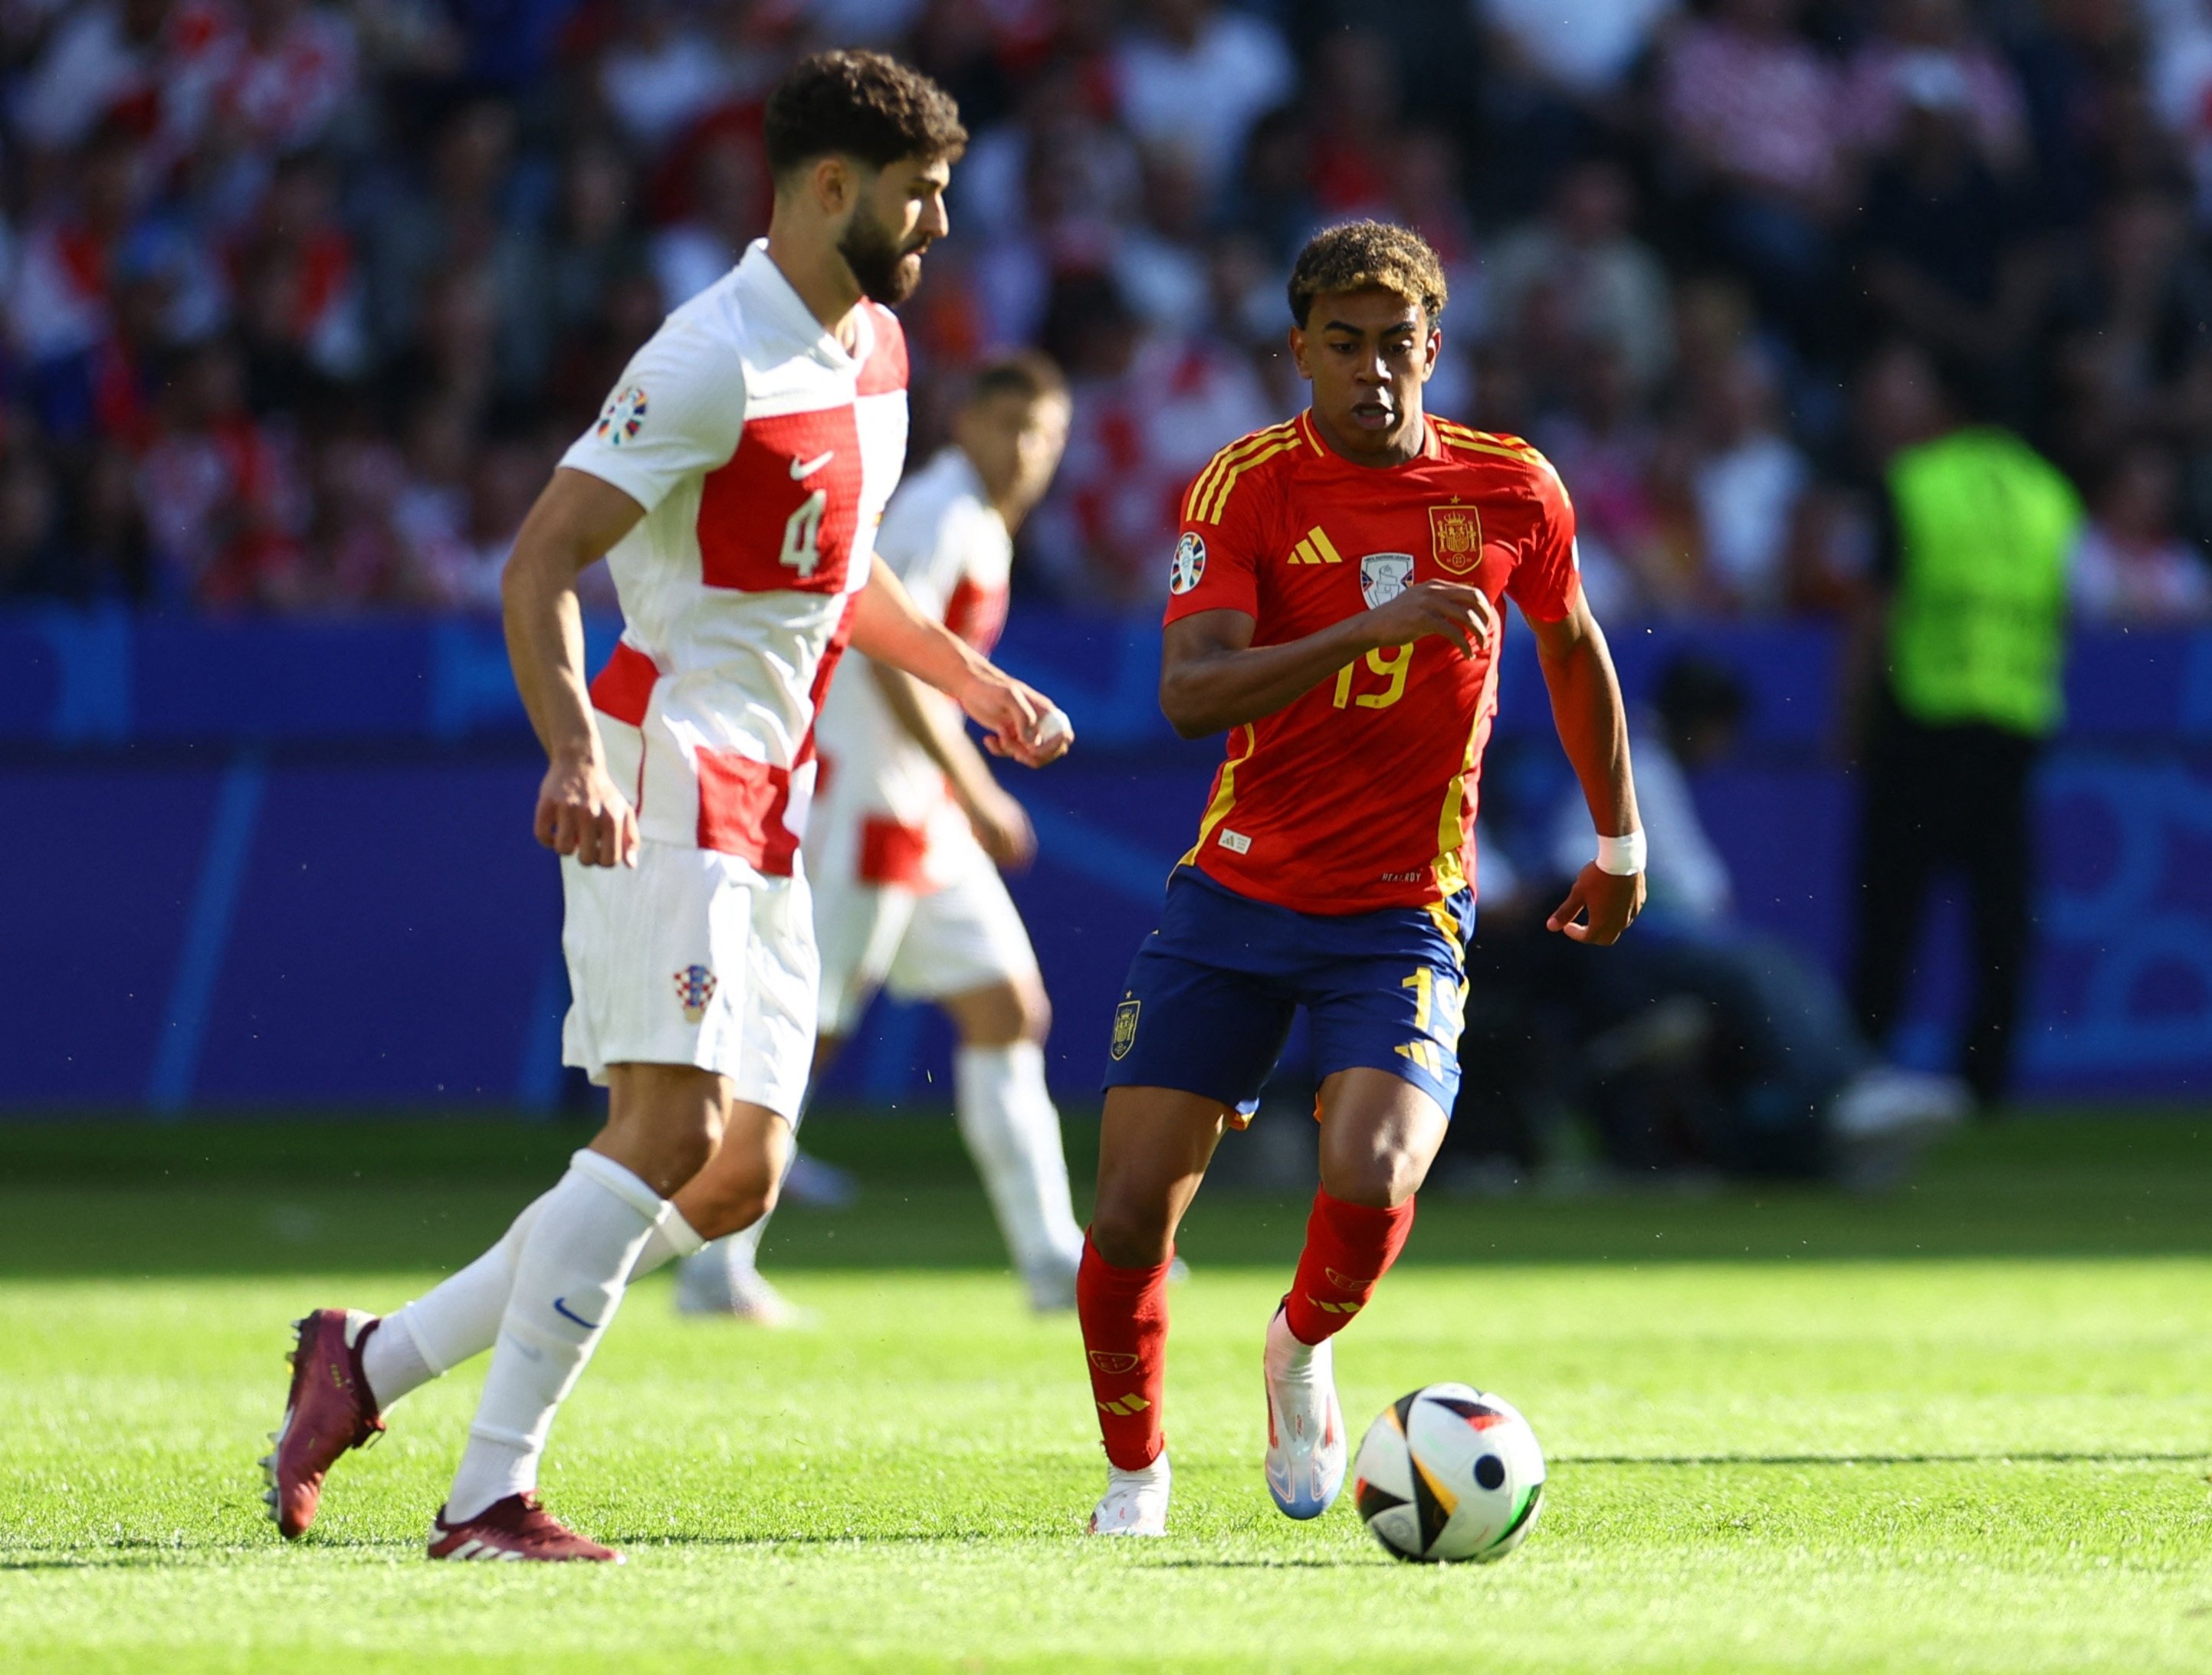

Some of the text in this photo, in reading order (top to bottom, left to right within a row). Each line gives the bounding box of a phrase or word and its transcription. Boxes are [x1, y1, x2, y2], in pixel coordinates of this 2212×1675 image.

[779, 488, 827, 578] 4
[1333, 641, 1414, 710] 19
[1402, 967, 1469, 1055] 19
